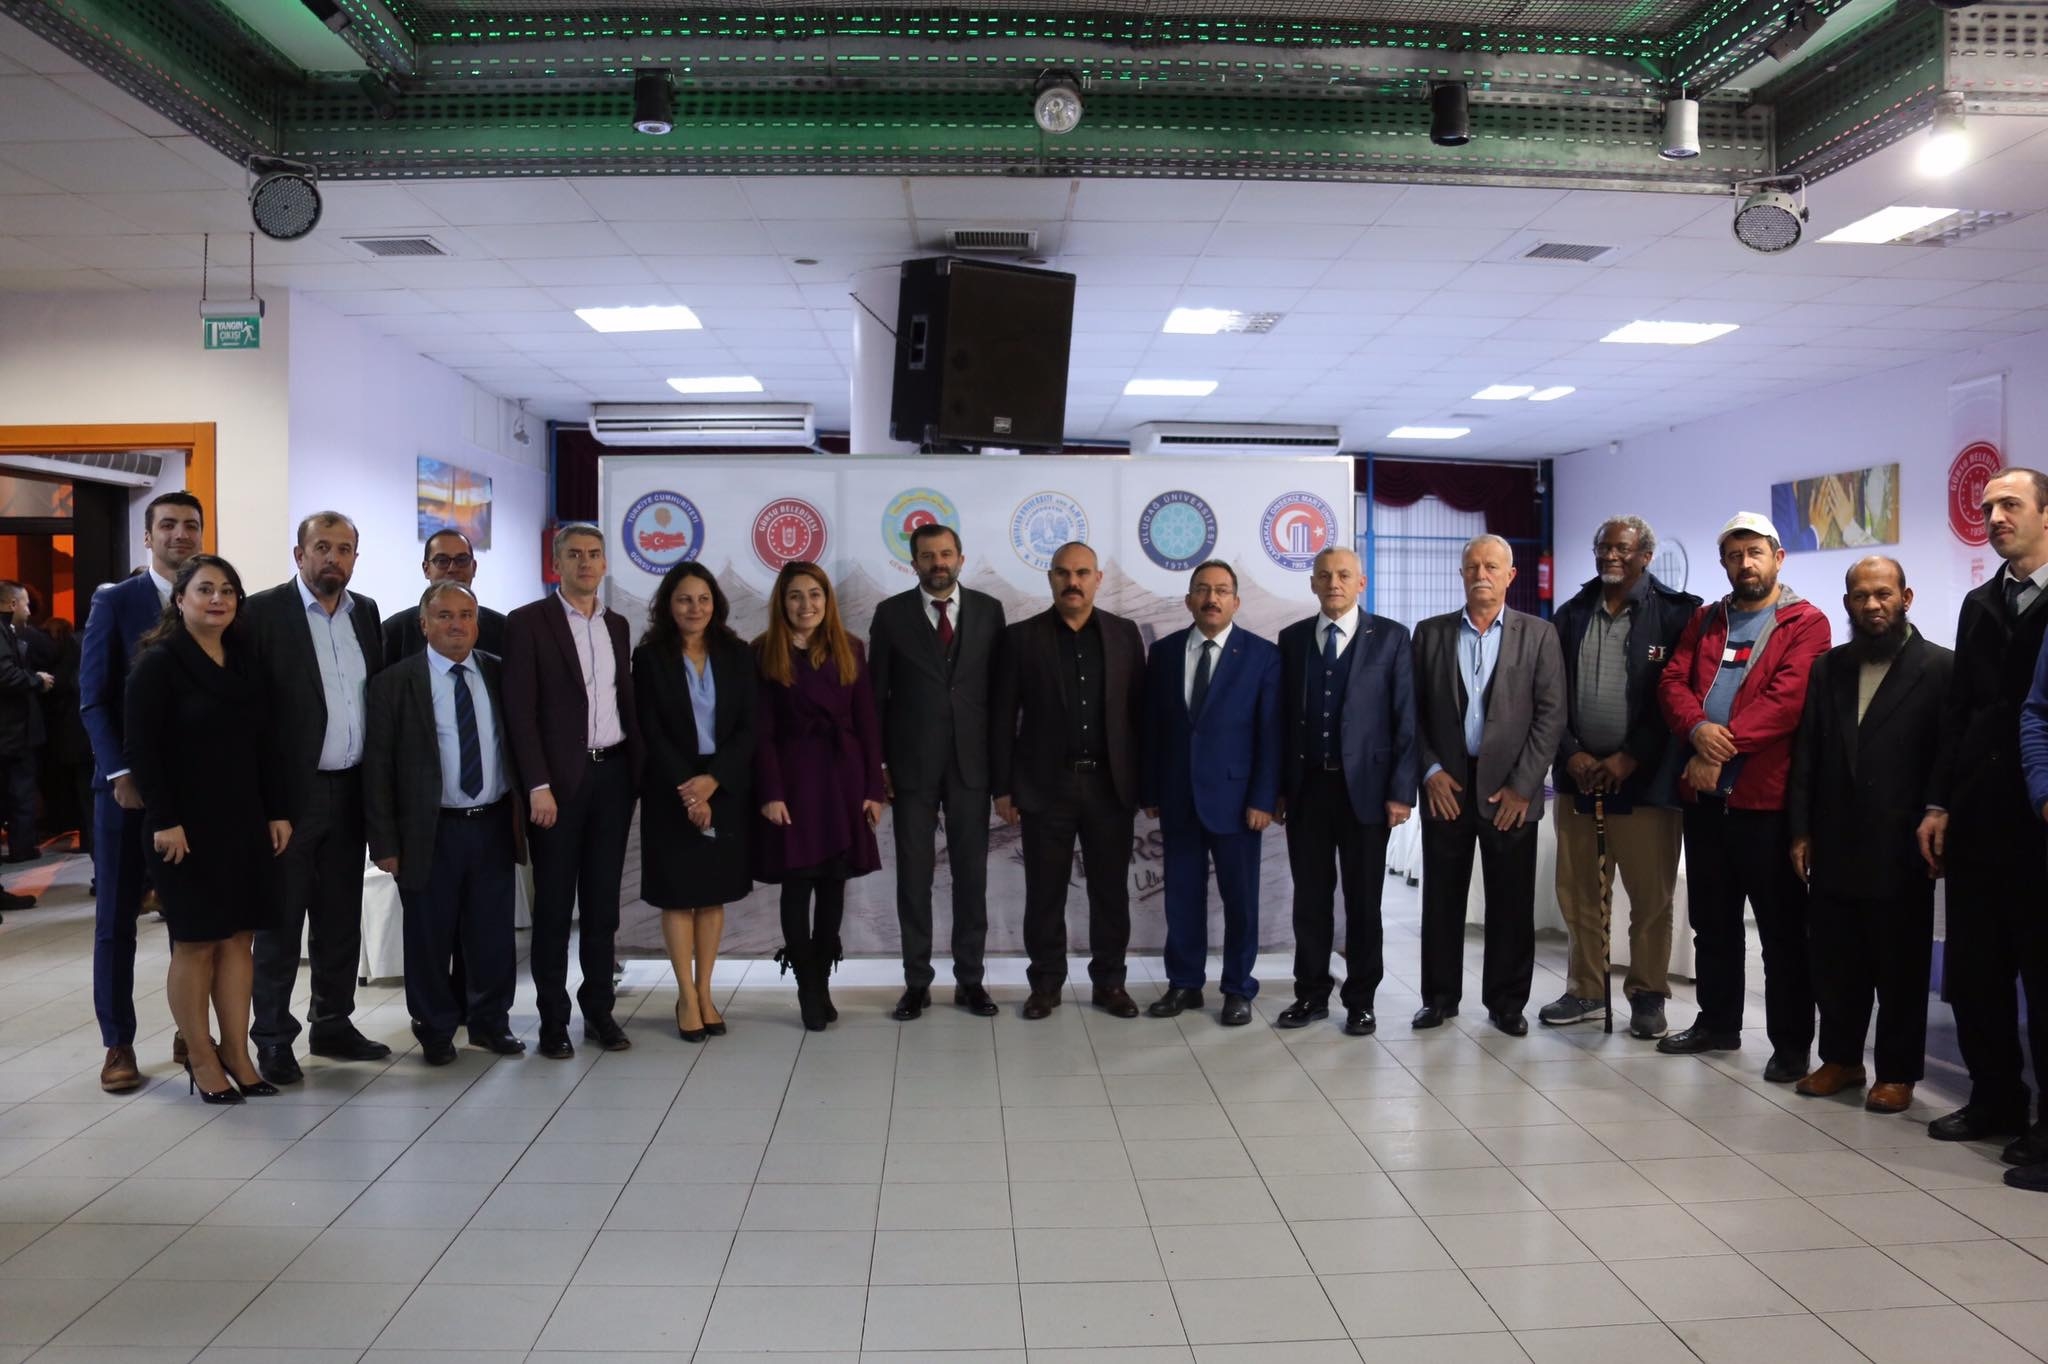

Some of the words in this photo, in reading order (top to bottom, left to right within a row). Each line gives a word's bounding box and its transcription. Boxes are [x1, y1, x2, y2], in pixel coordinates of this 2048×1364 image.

[218, 321, 243, 330] YANGIN
[1142, 501, 1160, 544] ULUDAĞ
[1165, 561, 1189, 569] 1975
